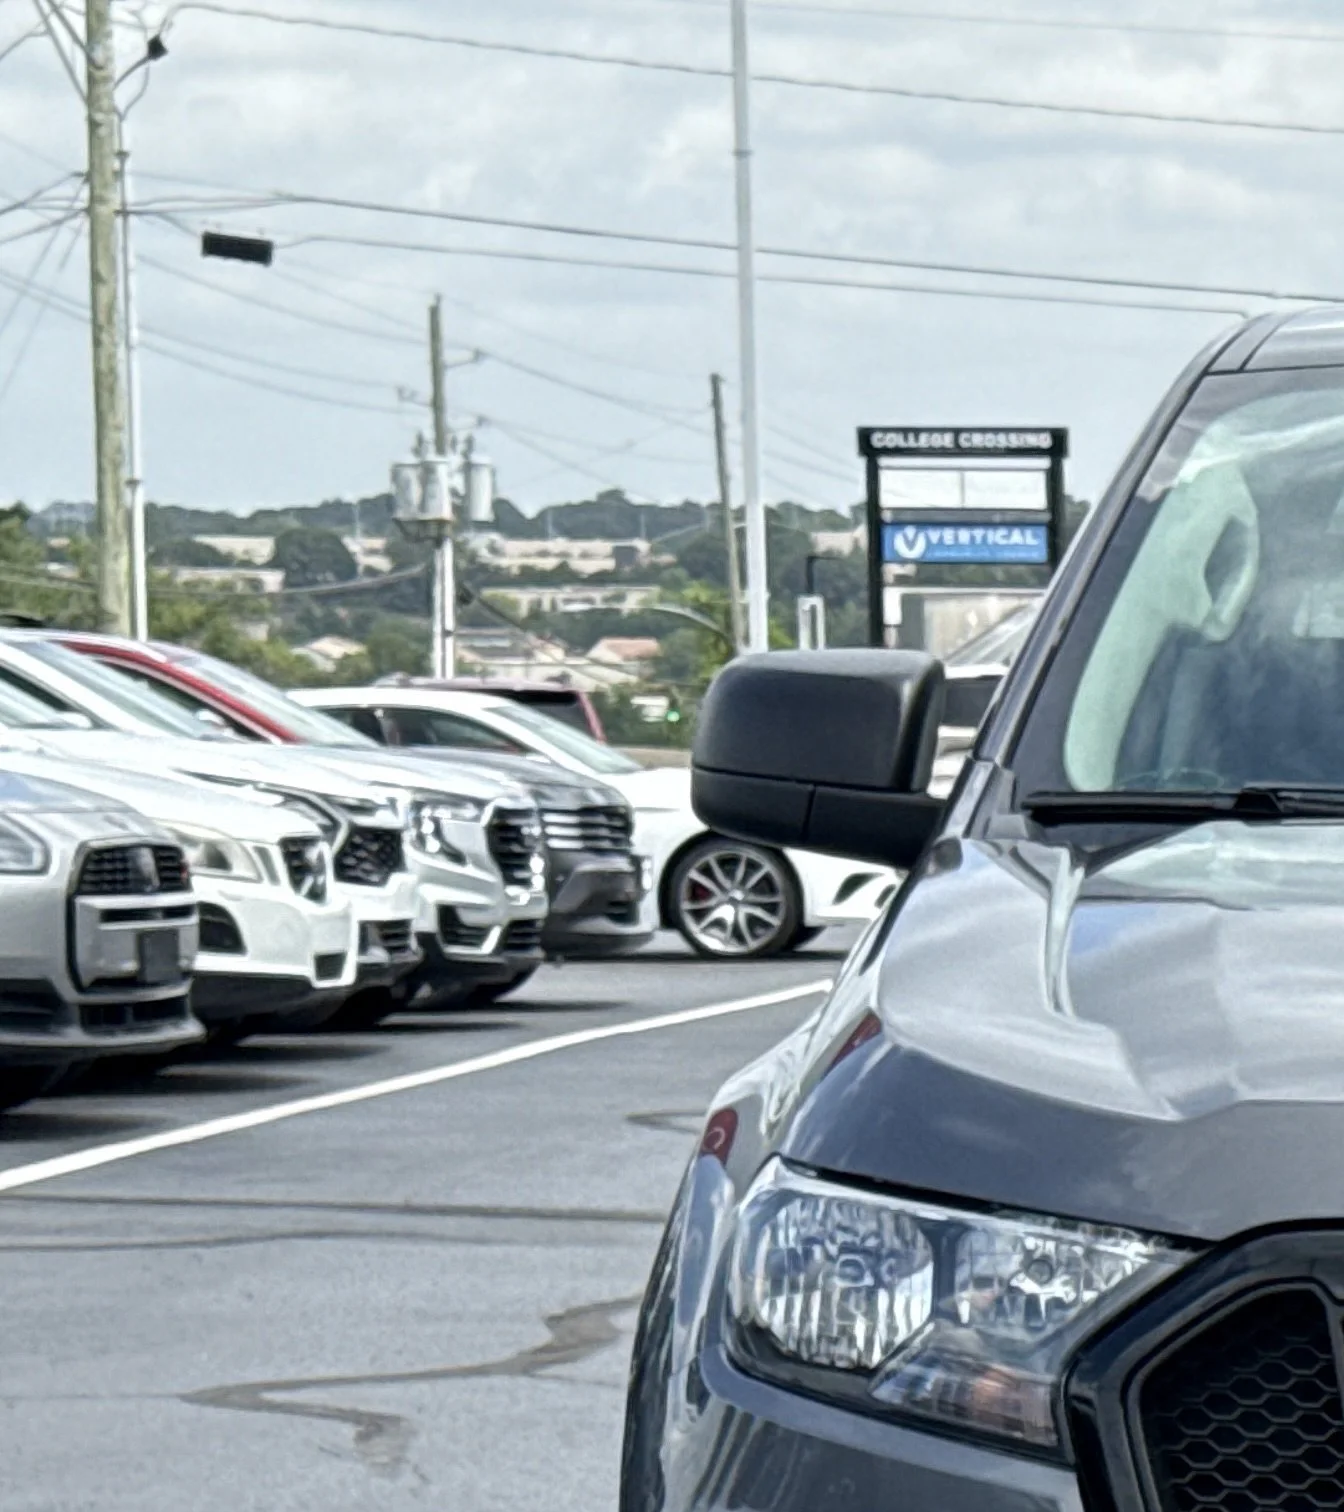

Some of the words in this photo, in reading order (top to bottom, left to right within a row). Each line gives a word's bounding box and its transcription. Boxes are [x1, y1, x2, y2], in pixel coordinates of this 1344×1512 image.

[870, 432, 955, 448] COLLEGE
[958, 432, 1052, 449] CROSSING
[926, 526, 1039, 545] VERTICAL
